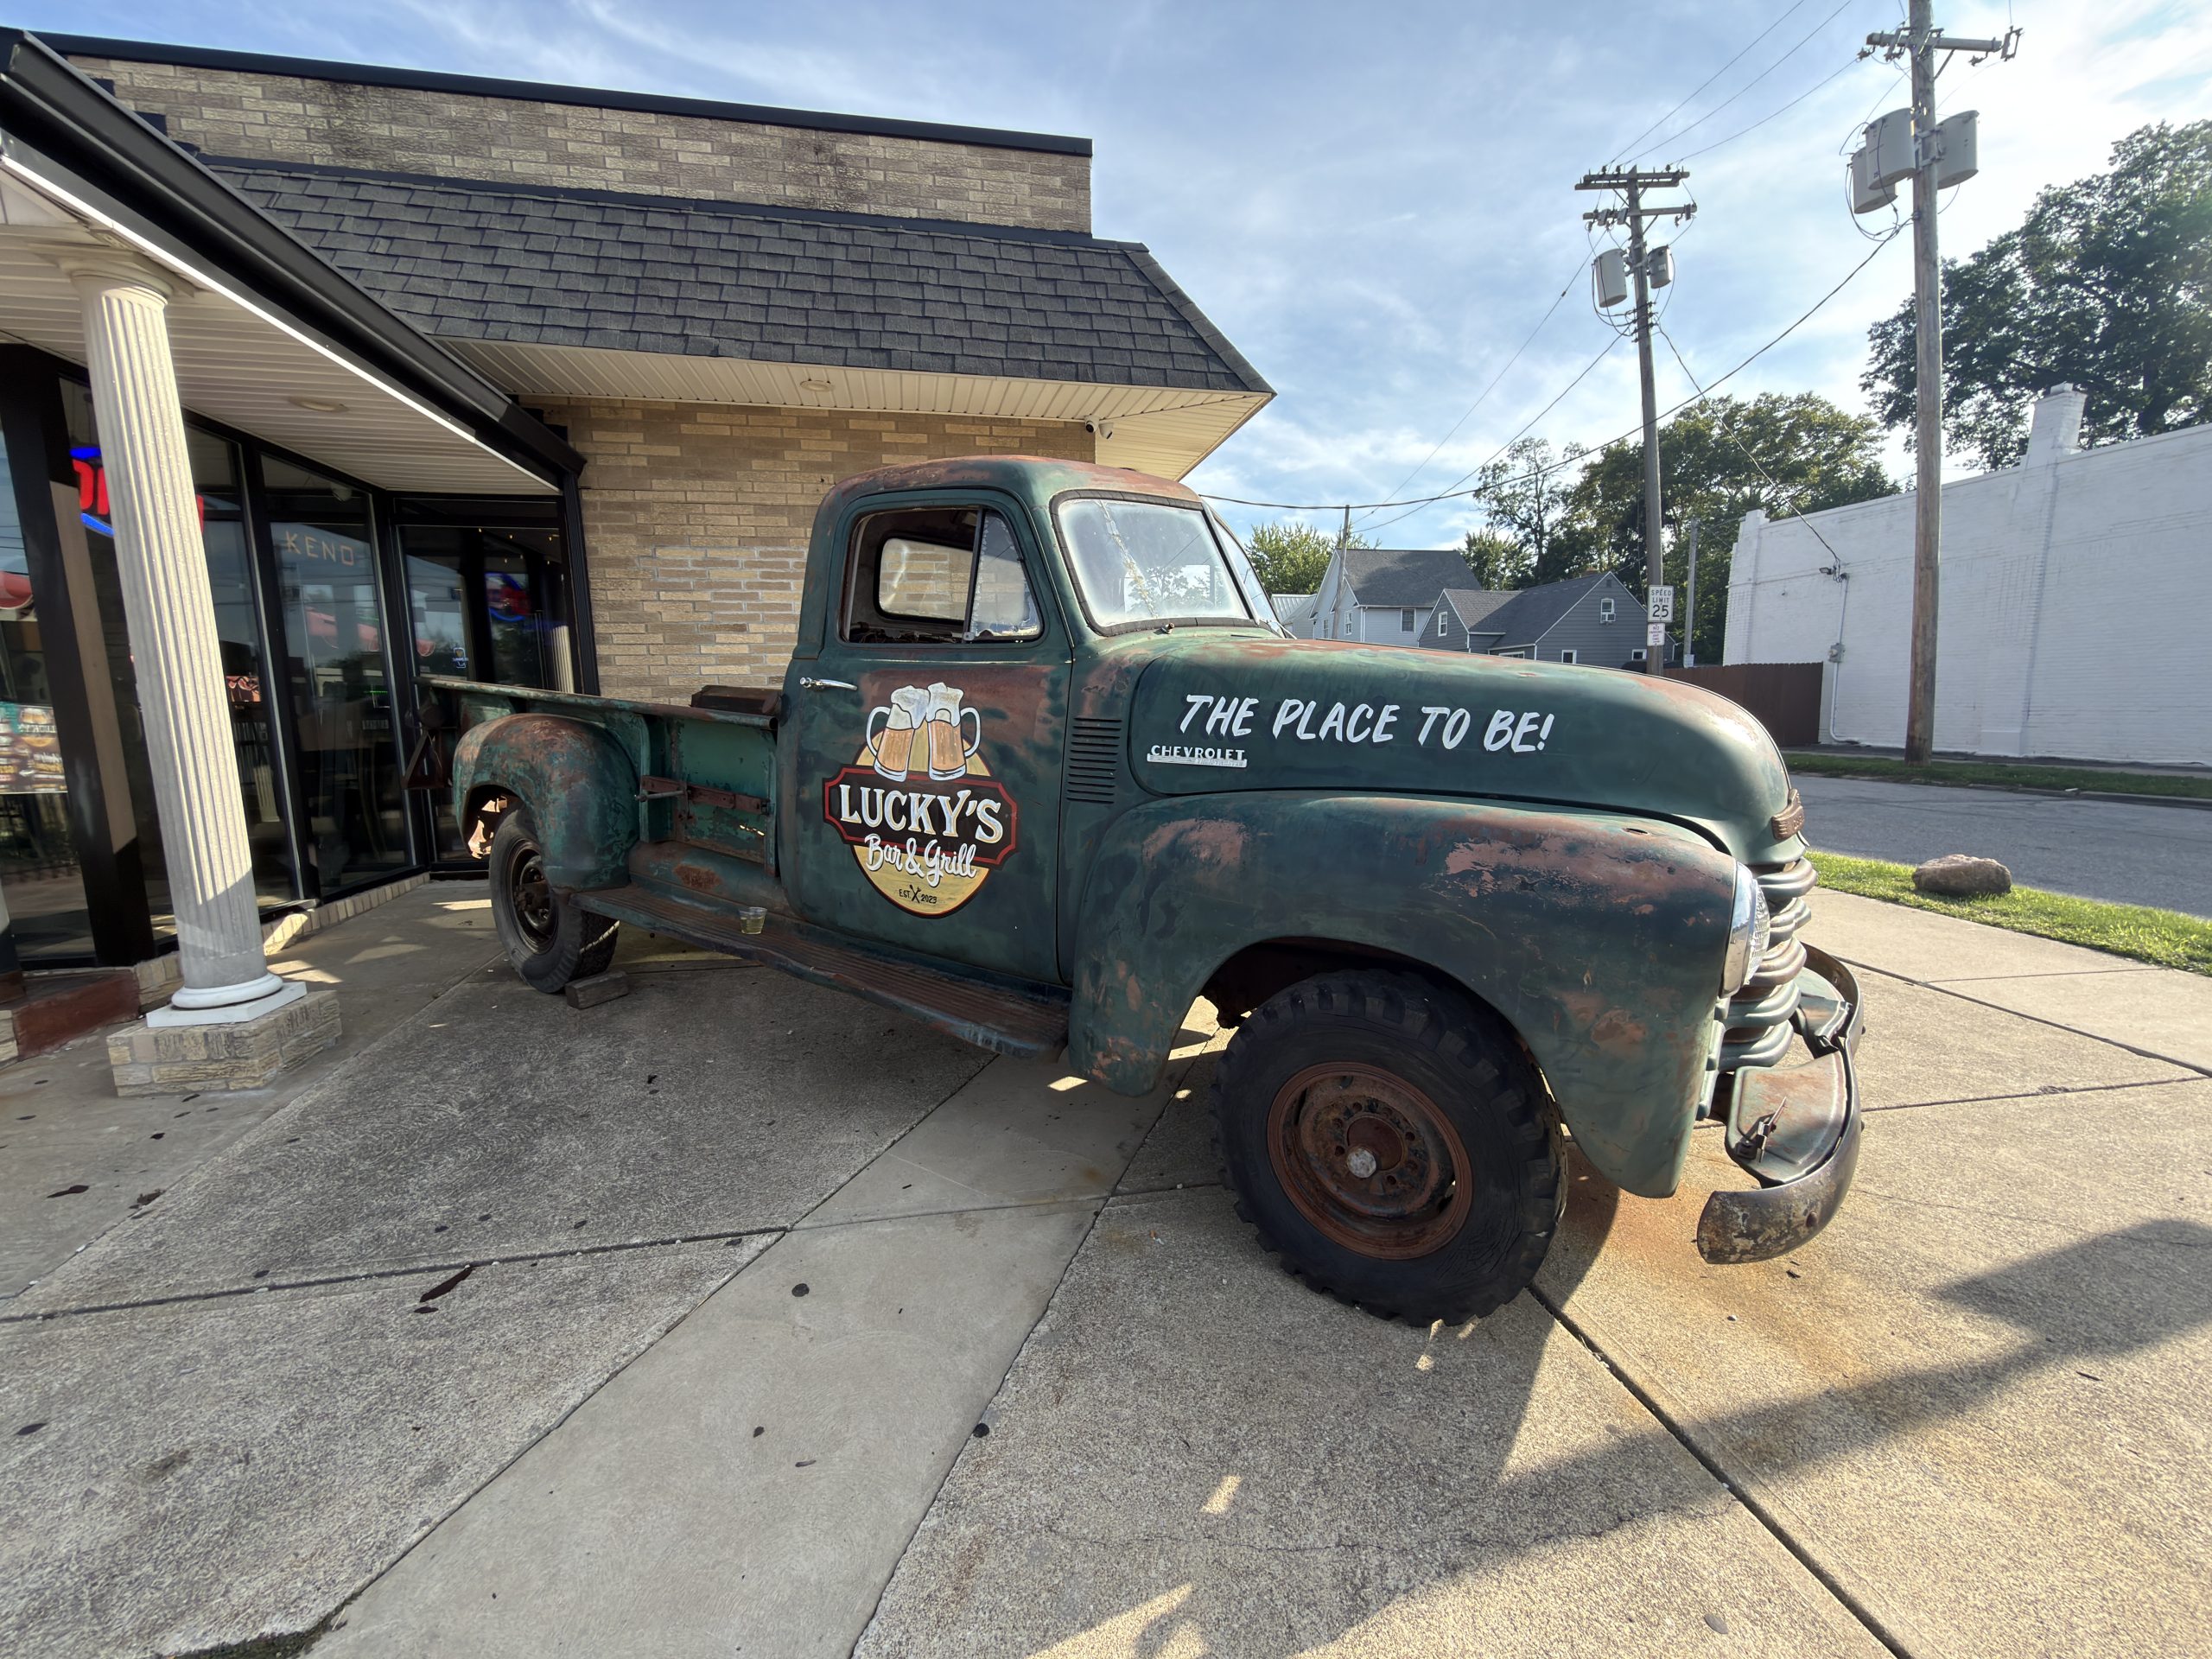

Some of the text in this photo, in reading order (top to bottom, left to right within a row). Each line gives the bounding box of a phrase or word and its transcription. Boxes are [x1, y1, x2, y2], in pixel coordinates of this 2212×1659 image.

[285, 531, 354, 566] KENO
[1652, 604, 1669, 618] 25
[1179, 694, 1555, 753] THE PLACE TO BE!
[1150, 744, 1245, 760] CHEVROLET
[839, 784, 1003, 843] LUCKY'S
[864, 833, 903, 871] Bar
[925, 839, 977, 887] Grill
[920, 894, 938, 904] 2023
